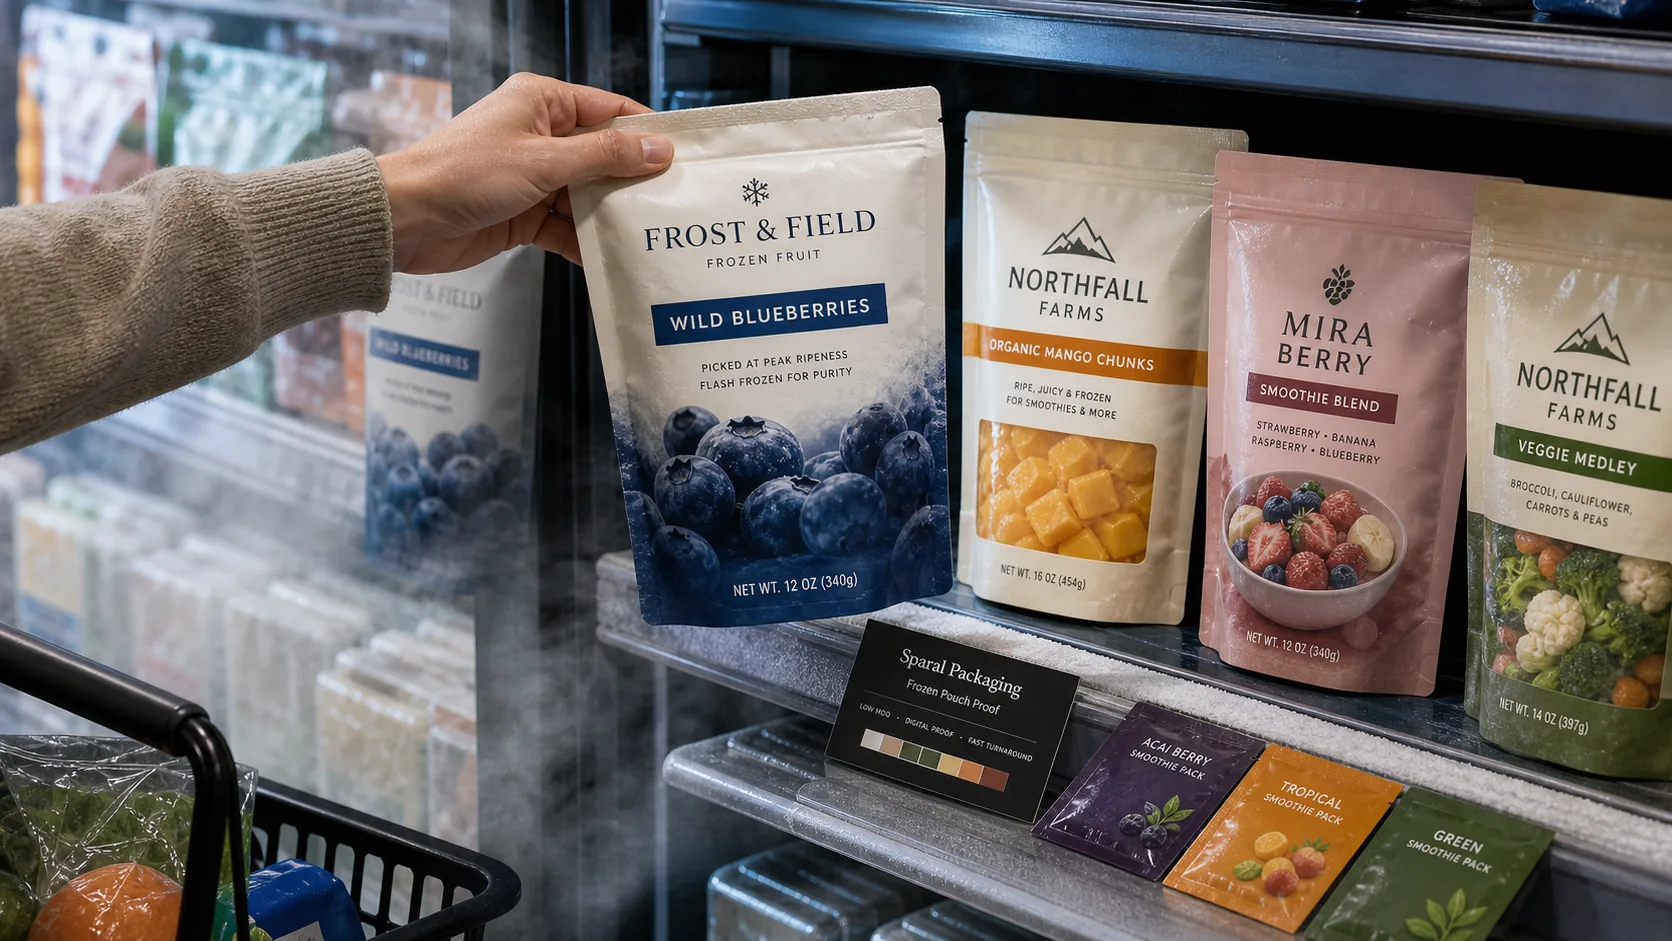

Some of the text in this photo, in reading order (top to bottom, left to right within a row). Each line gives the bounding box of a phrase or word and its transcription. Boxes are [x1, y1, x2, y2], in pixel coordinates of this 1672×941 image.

[644, 210, 876, 251] FROST & FIELD
[707, 249, 821, 268] FROZEN FRUIT
[1008, 266, 1149, 304] NORTHFALL
[670, 298, 870, 332] WILD BLUEBERRIES
[1039, 301, 1104, 322] FARMS
[1282, 311, 1373, 347] MIRA
[701, 350, 848, 373] PICKED AT PEAK RIPENESS
[989, 338, 1154, 371] ORGANIC MANGO CHUNKS
[1278, 343, 1372, 375] BERRY
[700, 367, 853, 390] FLASH FROZEN FOR PURITY
[1014, 381, 1112, 403] RIPE, JUICY & FROZEN
[1517, 362, 1662, 412] NORTHFALL
[1006, 396, 1117, 420] FOR SMOOTHIES & MORE
[1260, 383, 1380, 412] SMOOTHIE BLEND
[1547, 402, 1617, 431] FARMS
[1256, 420, 1376, 448] STRAWBERRY BANANA
[1252, 436, 1381, 465] RASPBERRY BLUEBERRY
[1518, 439, 1637, 476] VEGGIE MEDLEY
[1510, 479, 1633, 516] BROCCOLI, CAULIFLOWER,
[1526, 500, 1609, 527] CARROTS & PEAS
[733, 572, 858, 597] NET WT. 12 OZ (340g)
[1000, 564, 1086, 591] NET WT. 16 OZ (454g)
[1246, 631, 1340, 662] NET WT. 12 OZ (340g)
[900, 648, 1023, 700] Sparal Packaging
[906, 679, 1001, 715] Frozen Pouch Proof
[859, 702, 876, 713] LOW
[905, 717, 930, 731] DIGITAL
[930, 725, 955, 738] PROOF
[968, 736, 985, 749] FAST
[985, 742, 1033, 762] TURNAROUND
[1499, 697, 1589, 736] NET WT. 14 OZ (397g)
[1129, 749, 1206, 781] SMOOTHIE PACK
[1141, 737, 1212, 767] ACAI BERRY
[1264, 793, 1344, 825] SMOOTHIE PACK
[1280, 781, 1342, 810] TROPICAL
[1406, 839, 1493, 874] SMOOTHIE PACK
[1433, 830, 1484, 855] GREEN
